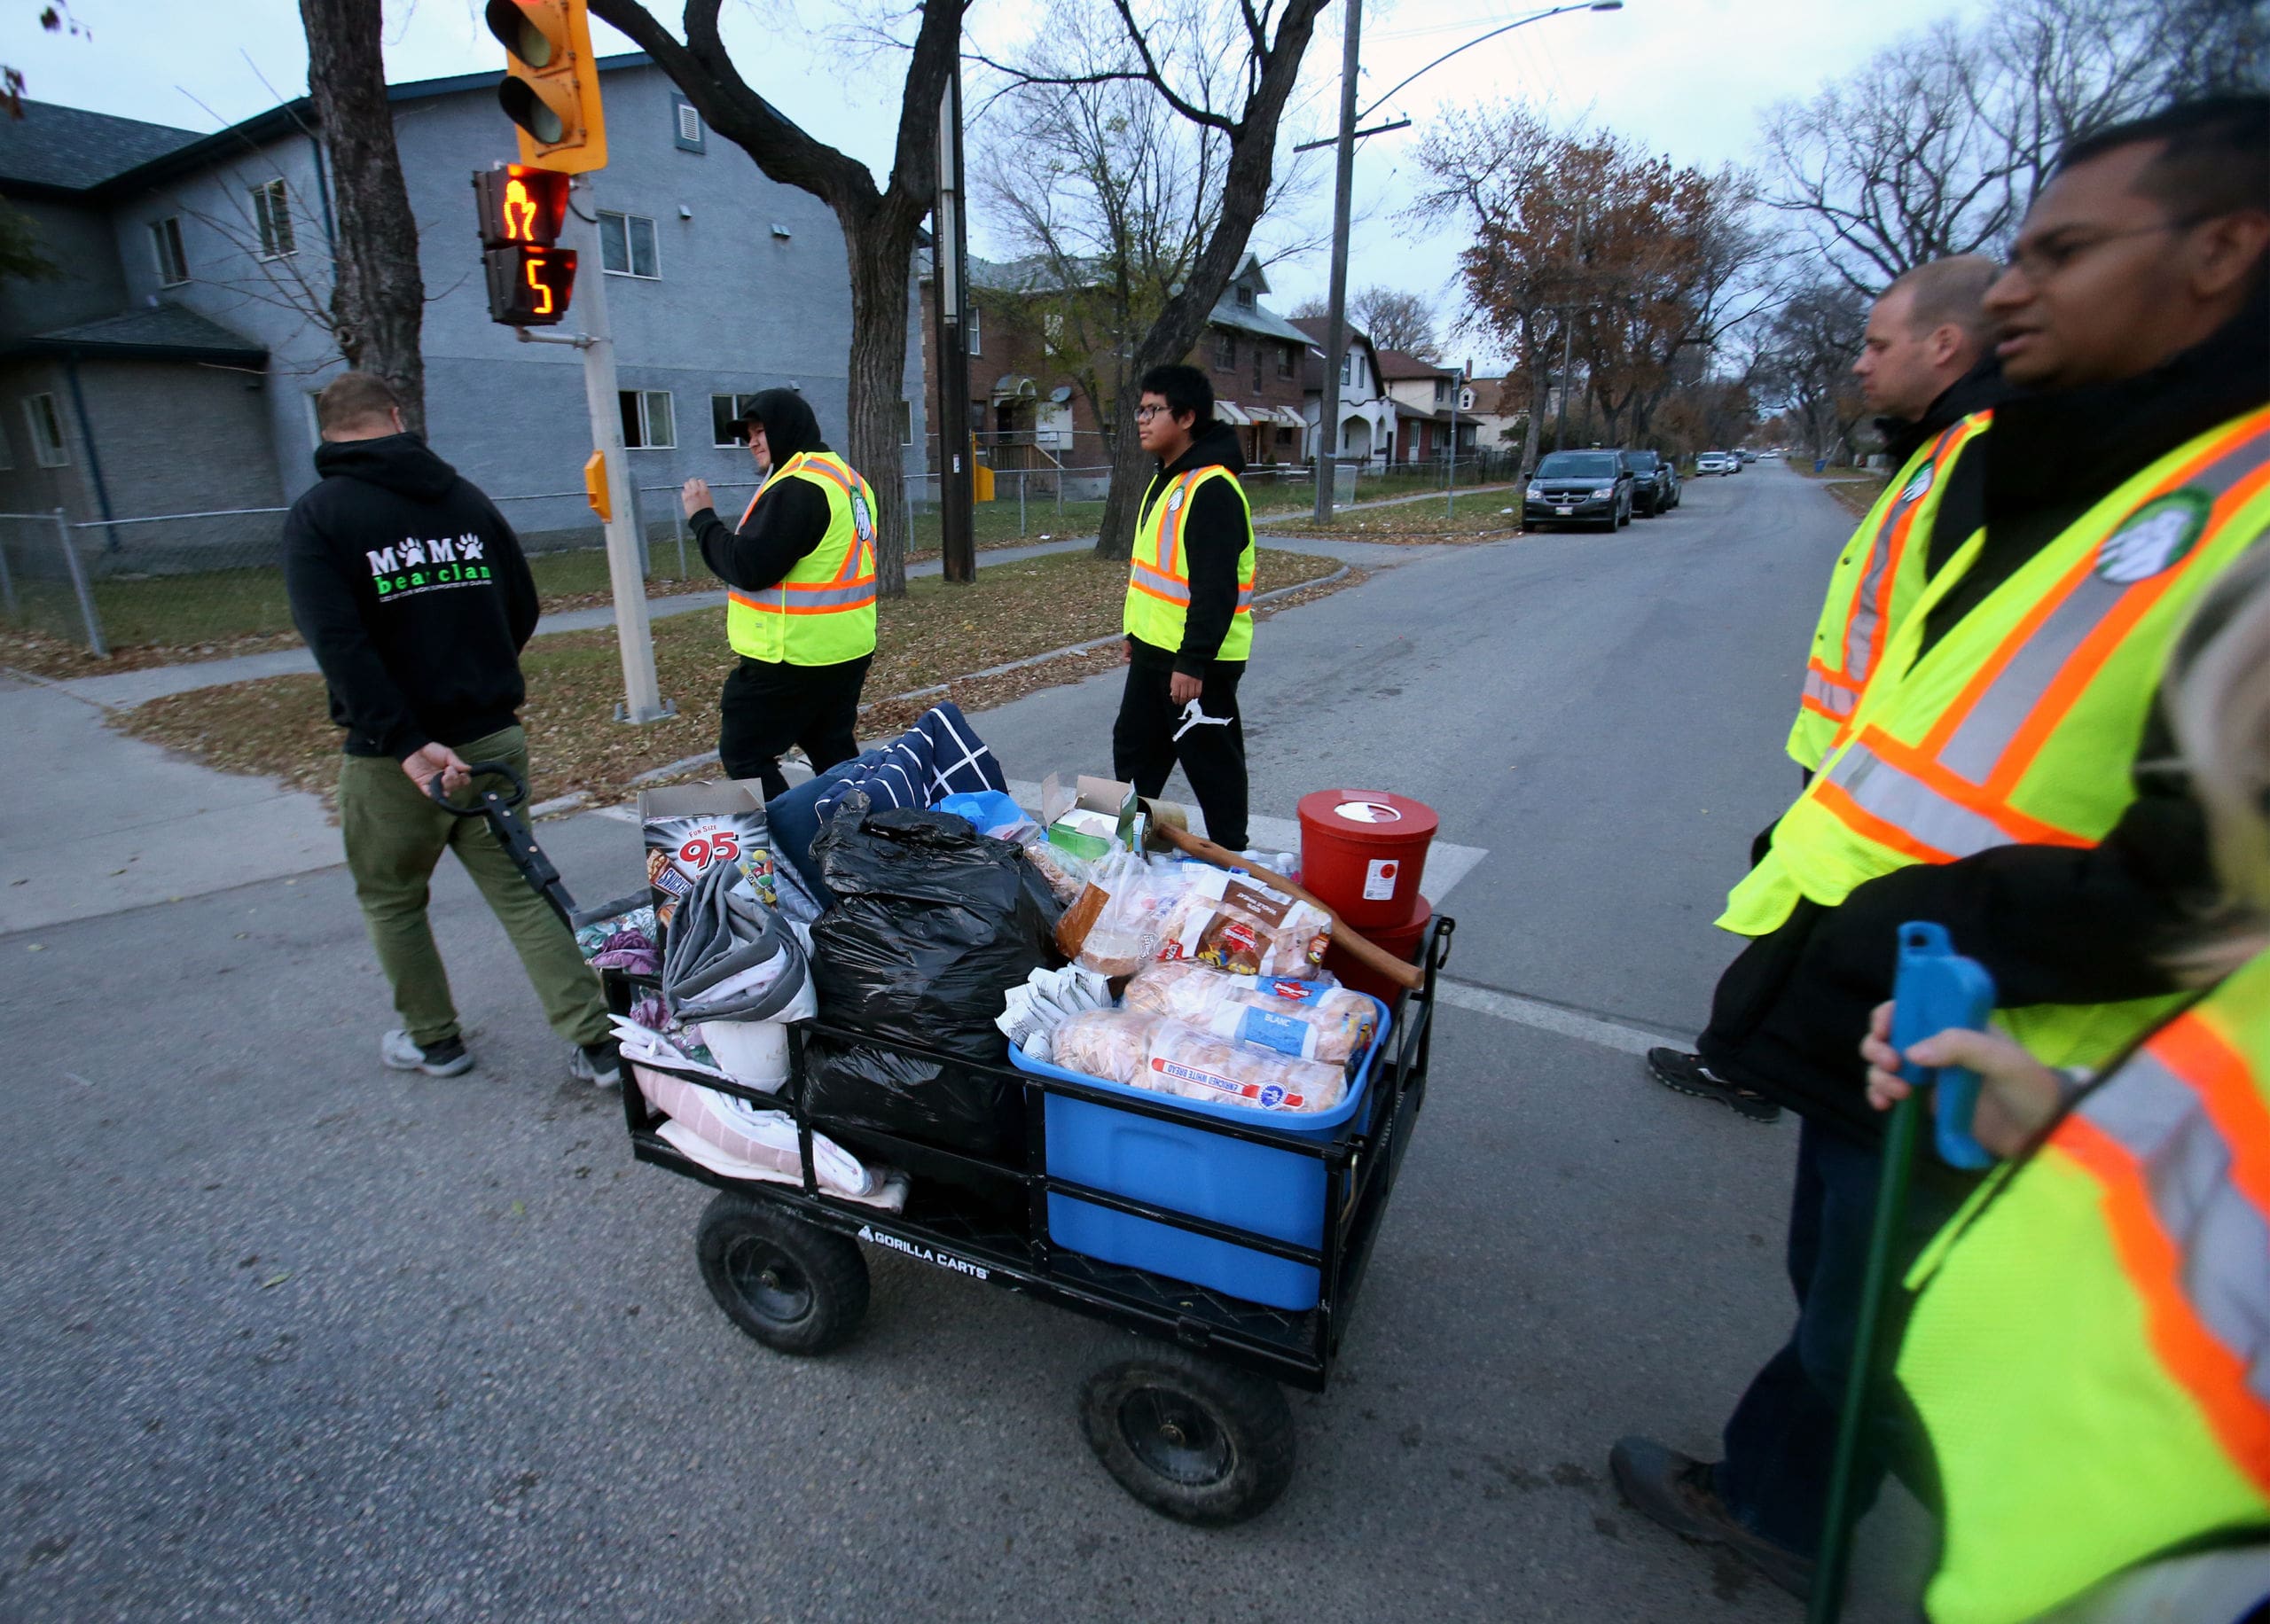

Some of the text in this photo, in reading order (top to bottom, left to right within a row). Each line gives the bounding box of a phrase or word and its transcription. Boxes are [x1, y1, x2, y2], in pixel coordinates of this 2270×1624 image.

[526, 259, 553, 314] 5
[438, 564, 490, 582] clan
[679, 832, 739, 869] 95
[1264, 1013, 1291, 1027] BLANC
[1168, 1064, 1239, 1091] ENRICHED WHITE BREAD
[874, 1231, 988, 1280] GORILLA CARTS
